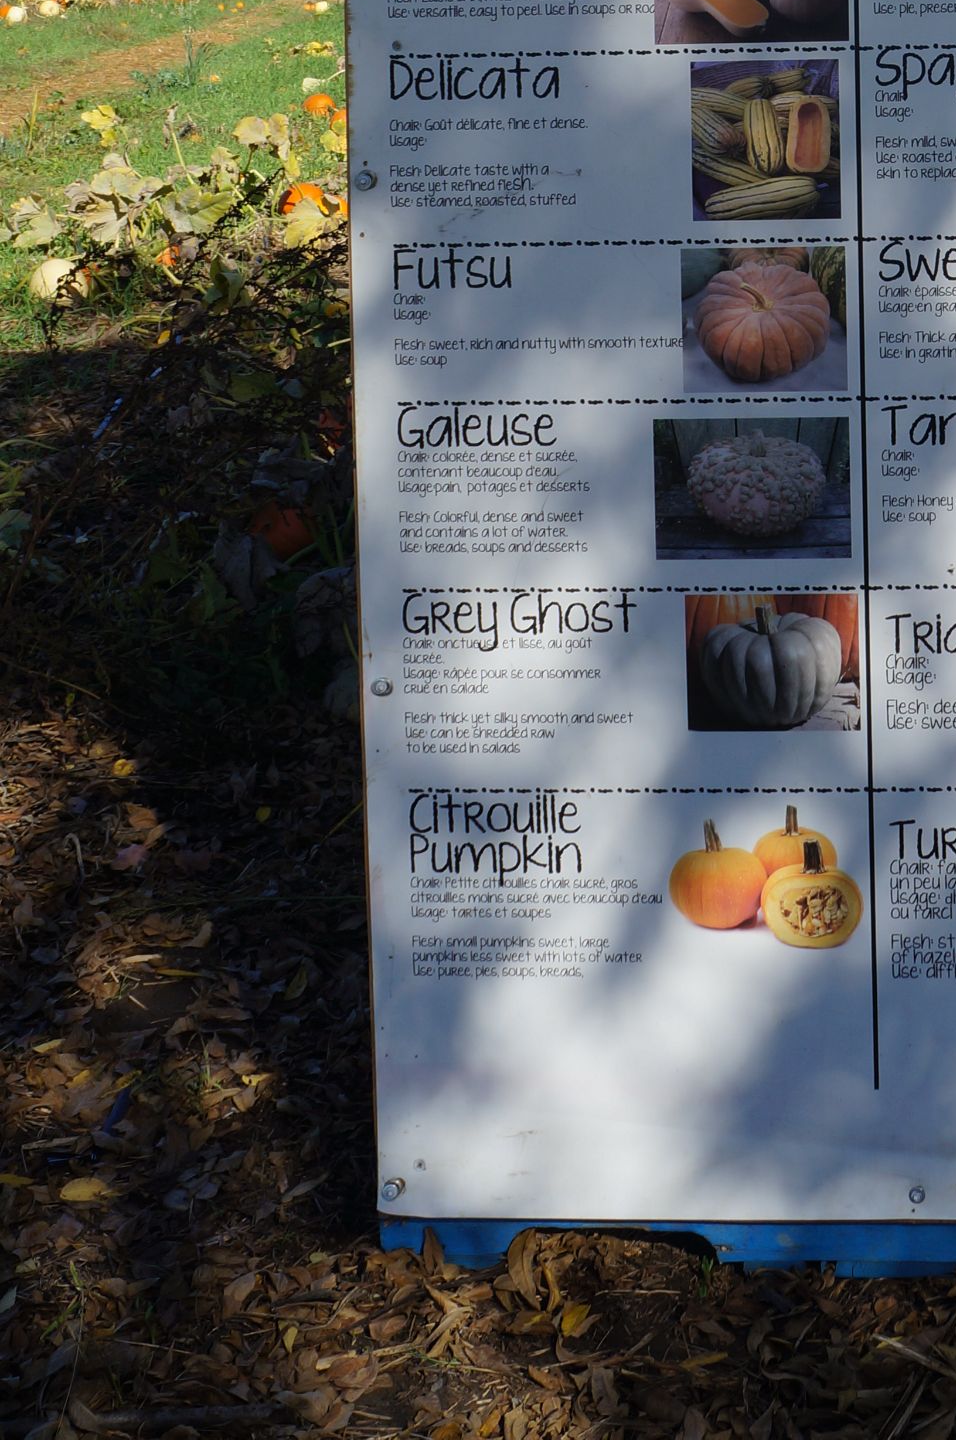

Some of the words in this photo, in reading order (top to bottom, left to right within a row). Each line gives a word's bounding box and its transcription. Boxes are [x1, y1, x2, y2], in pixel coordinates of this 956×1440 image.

[389, 58, 560, 101] Delicata
[393, 248, 512, 290] Futsu
[398, 406, 557, 449] Galeuse
[510, 592, 638, 636] Ghost
[410, 834, 583, 887] Pumpkin
